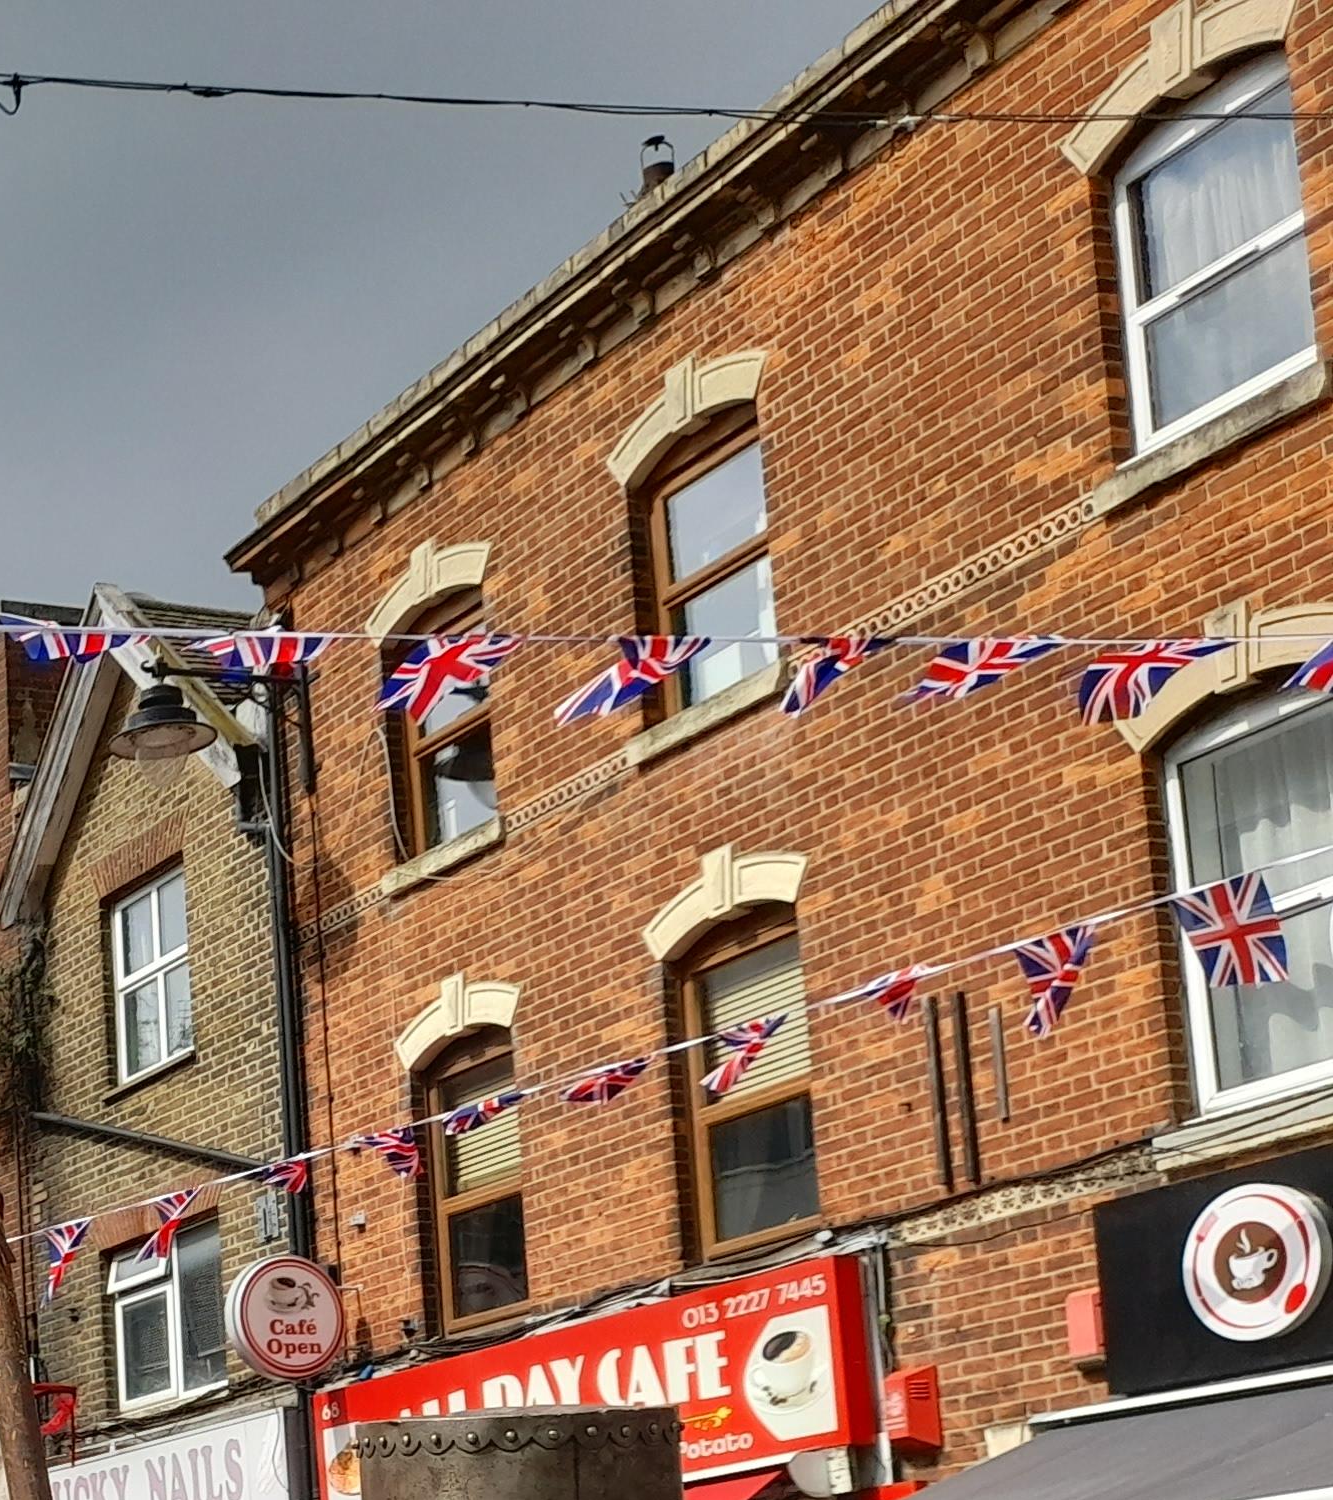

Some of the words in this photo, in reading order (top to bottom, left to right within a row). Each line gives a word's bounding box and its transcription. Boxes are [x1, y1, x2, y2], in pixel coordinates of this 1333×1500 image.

[683, 1303, 720, 1328] 013
[723, 1289, 771, 1319] 2227
[776, 1274, 827, 1305] 7445
[269, 1319, 318, 1335] Café
[266, 1338, 322, 1359] Open
[597, 1330, 732, 1407] CAFE
[322, 1402, 339, 1420] 68
